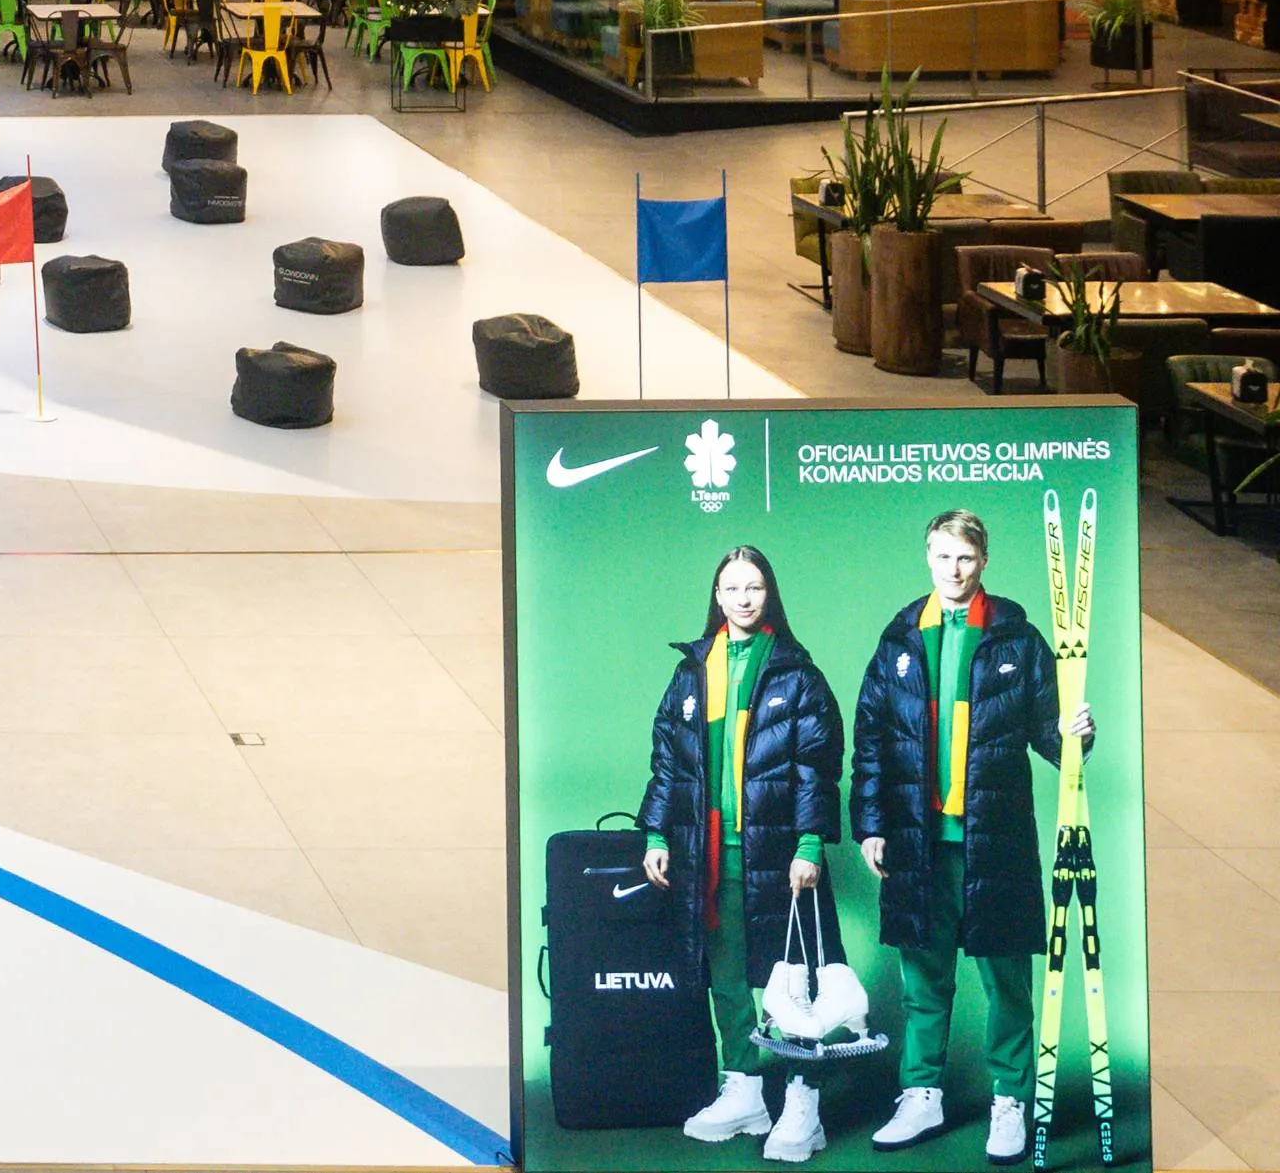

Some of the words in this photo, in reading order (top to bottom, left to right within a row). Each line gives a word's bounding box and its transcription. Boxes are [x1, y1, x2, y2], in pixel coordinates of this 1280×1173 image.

[798, 444, 884, 463] OFICIALI
[889, 442, 990, 462] LIETUVOS
[995, 437, 1111, 461] OLIMPINĖS
[799, 464, 922, 483] KOMANDOS
[927, 462, 1044, 482] KOLEKCIJA
[691, 490, 730, 501] LTeam
[1044, 521, 1067, 631] FISCHER
[1076, 519, 1093, 631] FISCHER
[595, 972, 675, 989] LIETUVA
